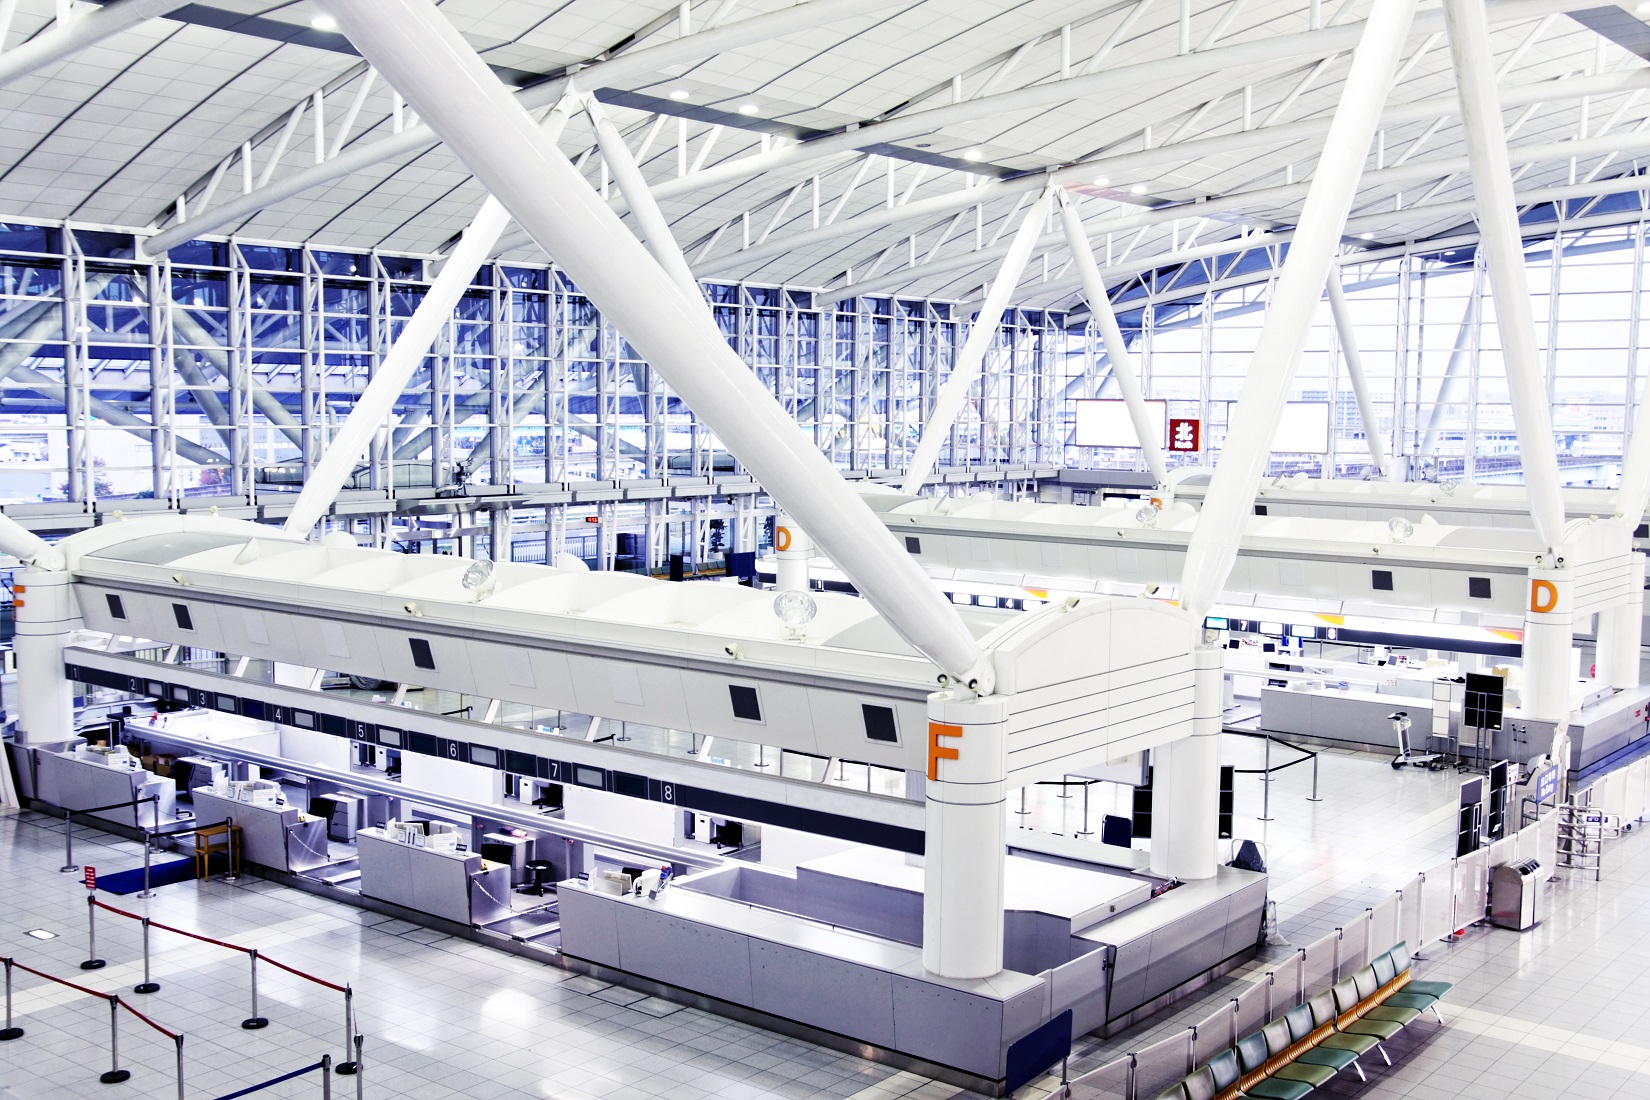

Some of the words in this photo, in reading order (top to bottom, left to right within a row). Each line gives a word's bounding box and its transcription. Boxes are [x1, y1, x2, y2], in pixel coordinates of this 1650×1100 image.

[1175, 422, 1193, 441] 北
[776, 526, 791, 552] D
[1531, 579, 1558, 613] D
[1240, 620, 1248, 631] 7
[73, 667, 78, 679] 1
[130, 678, 136, 691] 2
[199, 692, 206, 705] 3
[275, 708, 282, 721] 4
[358, 724, 365, 738] 5
[449, 743, 458, 757] 6
[928, 722, 963, 782] F
[551, 762, 559, 778] 7
[664, 785, 673, 801] 8
